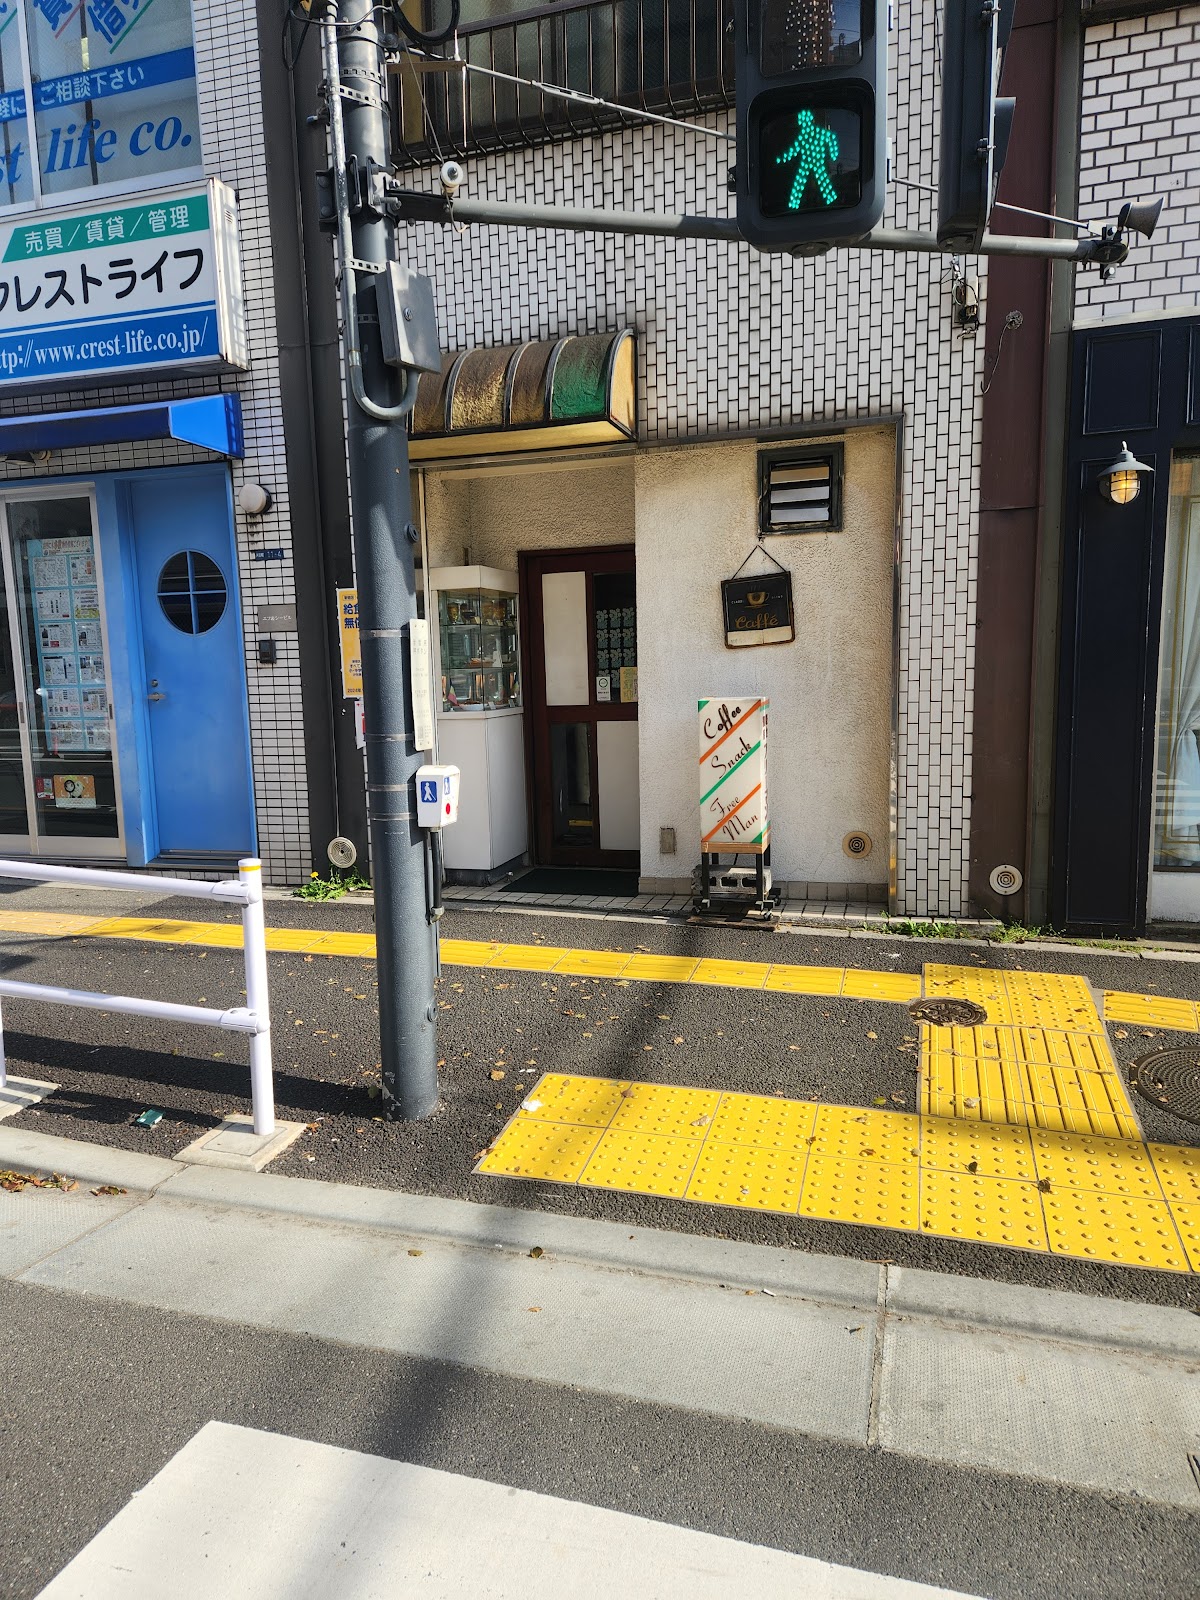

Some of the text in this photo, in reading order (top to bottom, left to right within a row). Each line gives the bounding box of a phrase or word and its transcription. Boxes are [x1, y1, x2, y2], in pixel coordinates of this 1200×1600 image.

[40, 66, 145, 106] ご相談下さい
[43, 118, 118, 174] life
[129, 116, 192, 157] co.
[703, 703, 742, 739] Coffee
[710, 736, 752, 779] Snack
[709, 796, 741, 823] Free
[722, 813, 759, 841] Man
